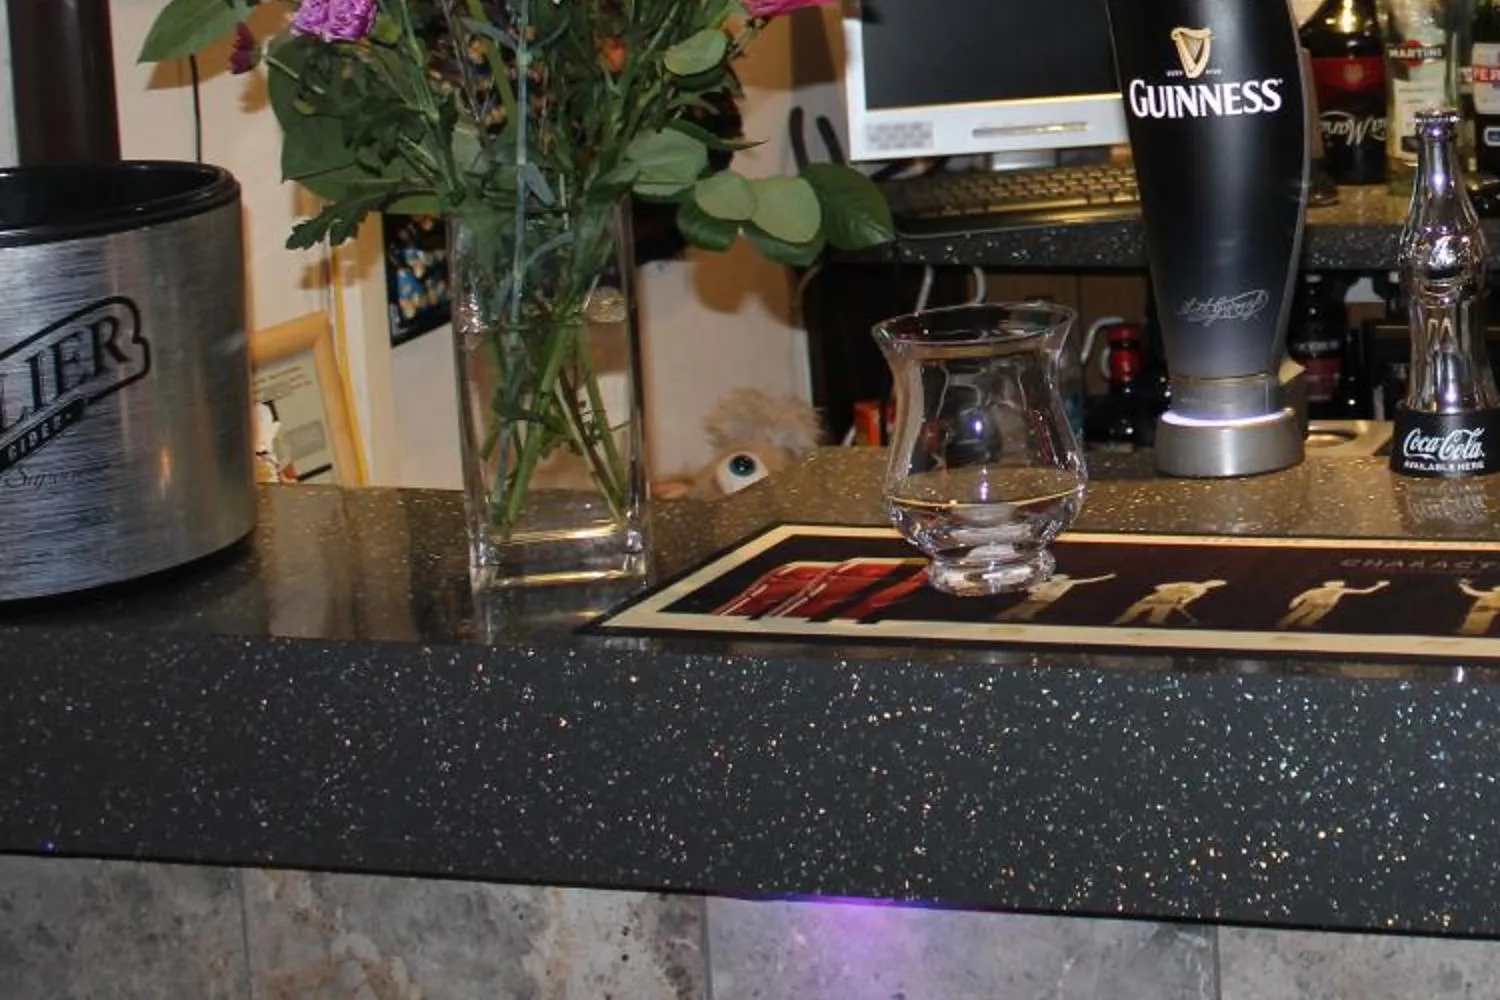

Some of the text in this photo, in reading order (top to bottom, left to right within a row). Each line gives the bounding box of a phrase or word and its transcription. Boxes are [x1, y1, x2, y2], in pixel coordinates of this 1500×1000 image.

[1388, 46, 1443, 58] MARTINI
[1129, 78, 1283, 119] GUINNESS
[0, 314, 133, 434] LIER
[1403, 427, 1486, 461] Coca-Cola
